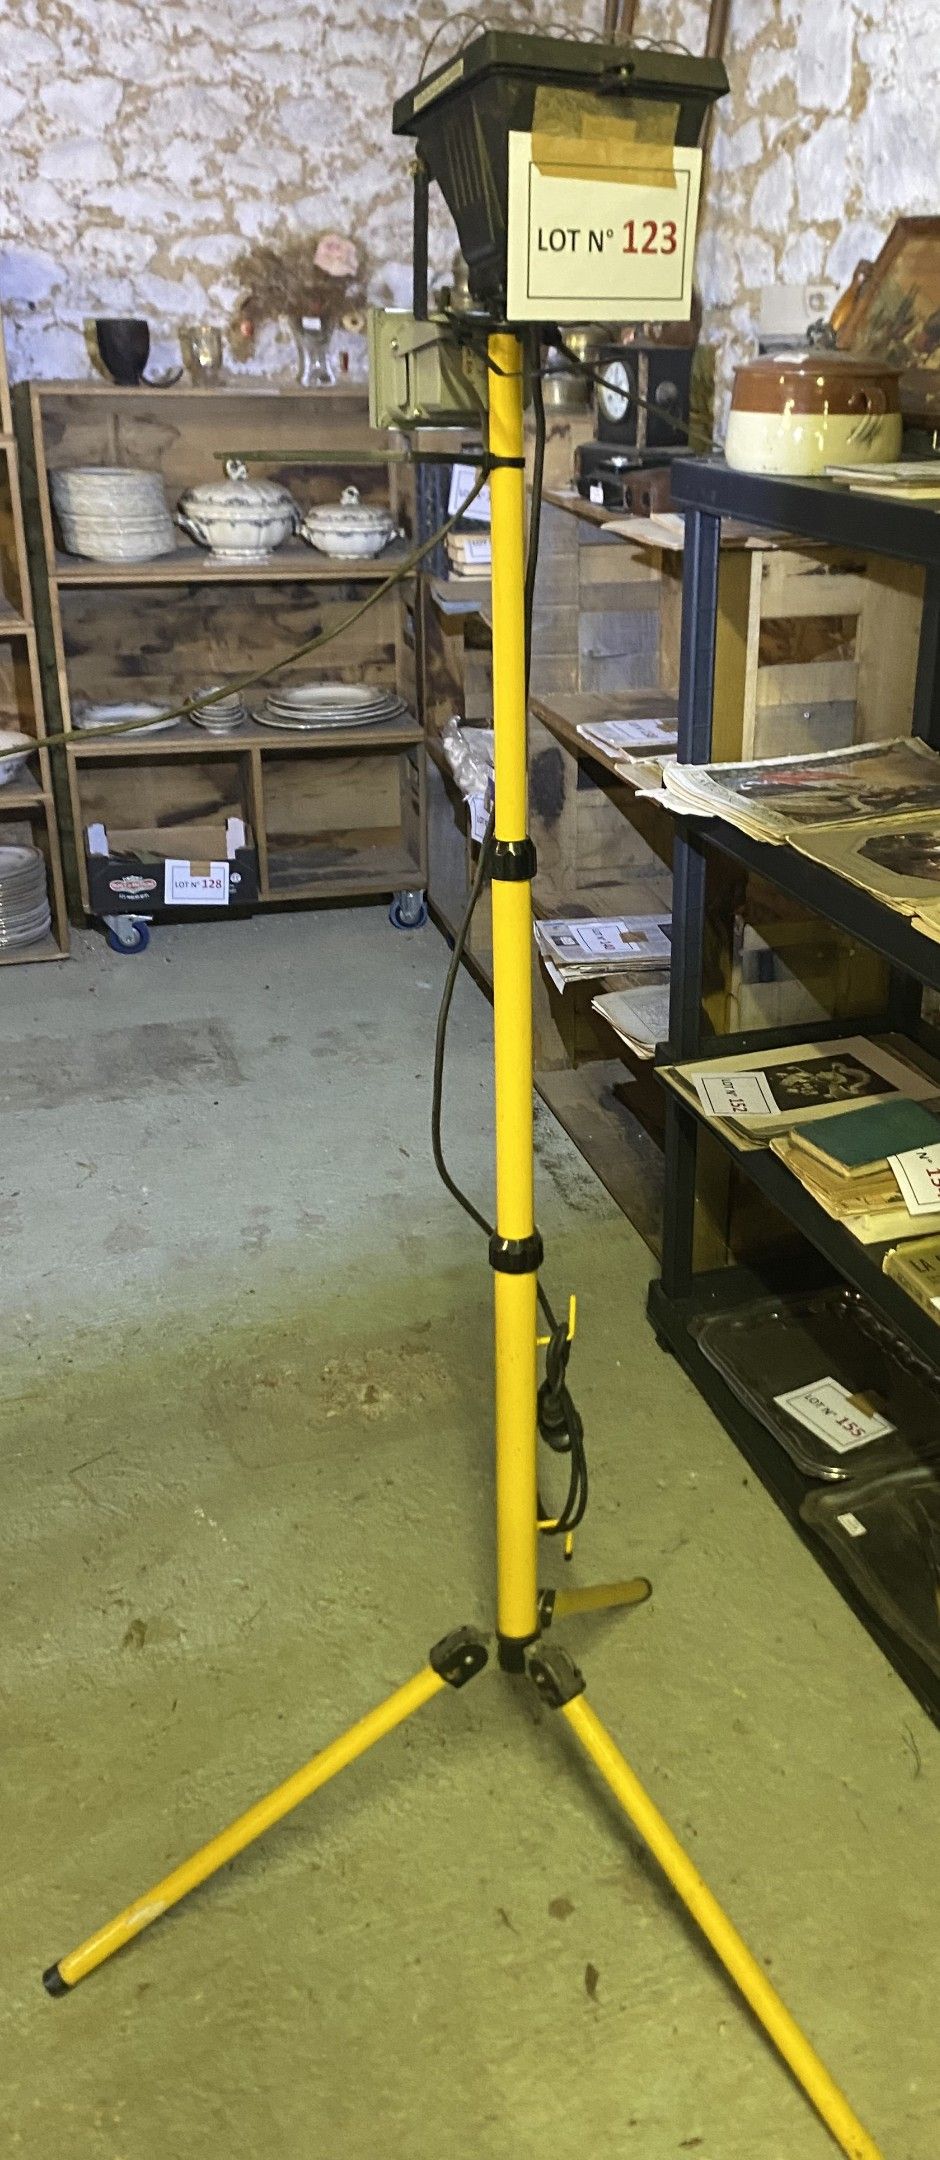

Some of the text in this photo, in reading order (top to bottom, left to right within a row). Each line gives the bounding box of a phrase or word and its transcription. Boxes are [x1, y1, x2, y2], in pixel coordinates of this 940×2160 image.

[538, 219, 677, 255] LOT N° 123
[175, 880, 189, 888] LOT
[202, 879, 222, 889] 128
[721, 1077, 735, 1089] LOT
[729, 1098, 748, 1112] 152
[804, 1393, 826, 1408] LOT
[835, 1416, 867, 1437] 155
